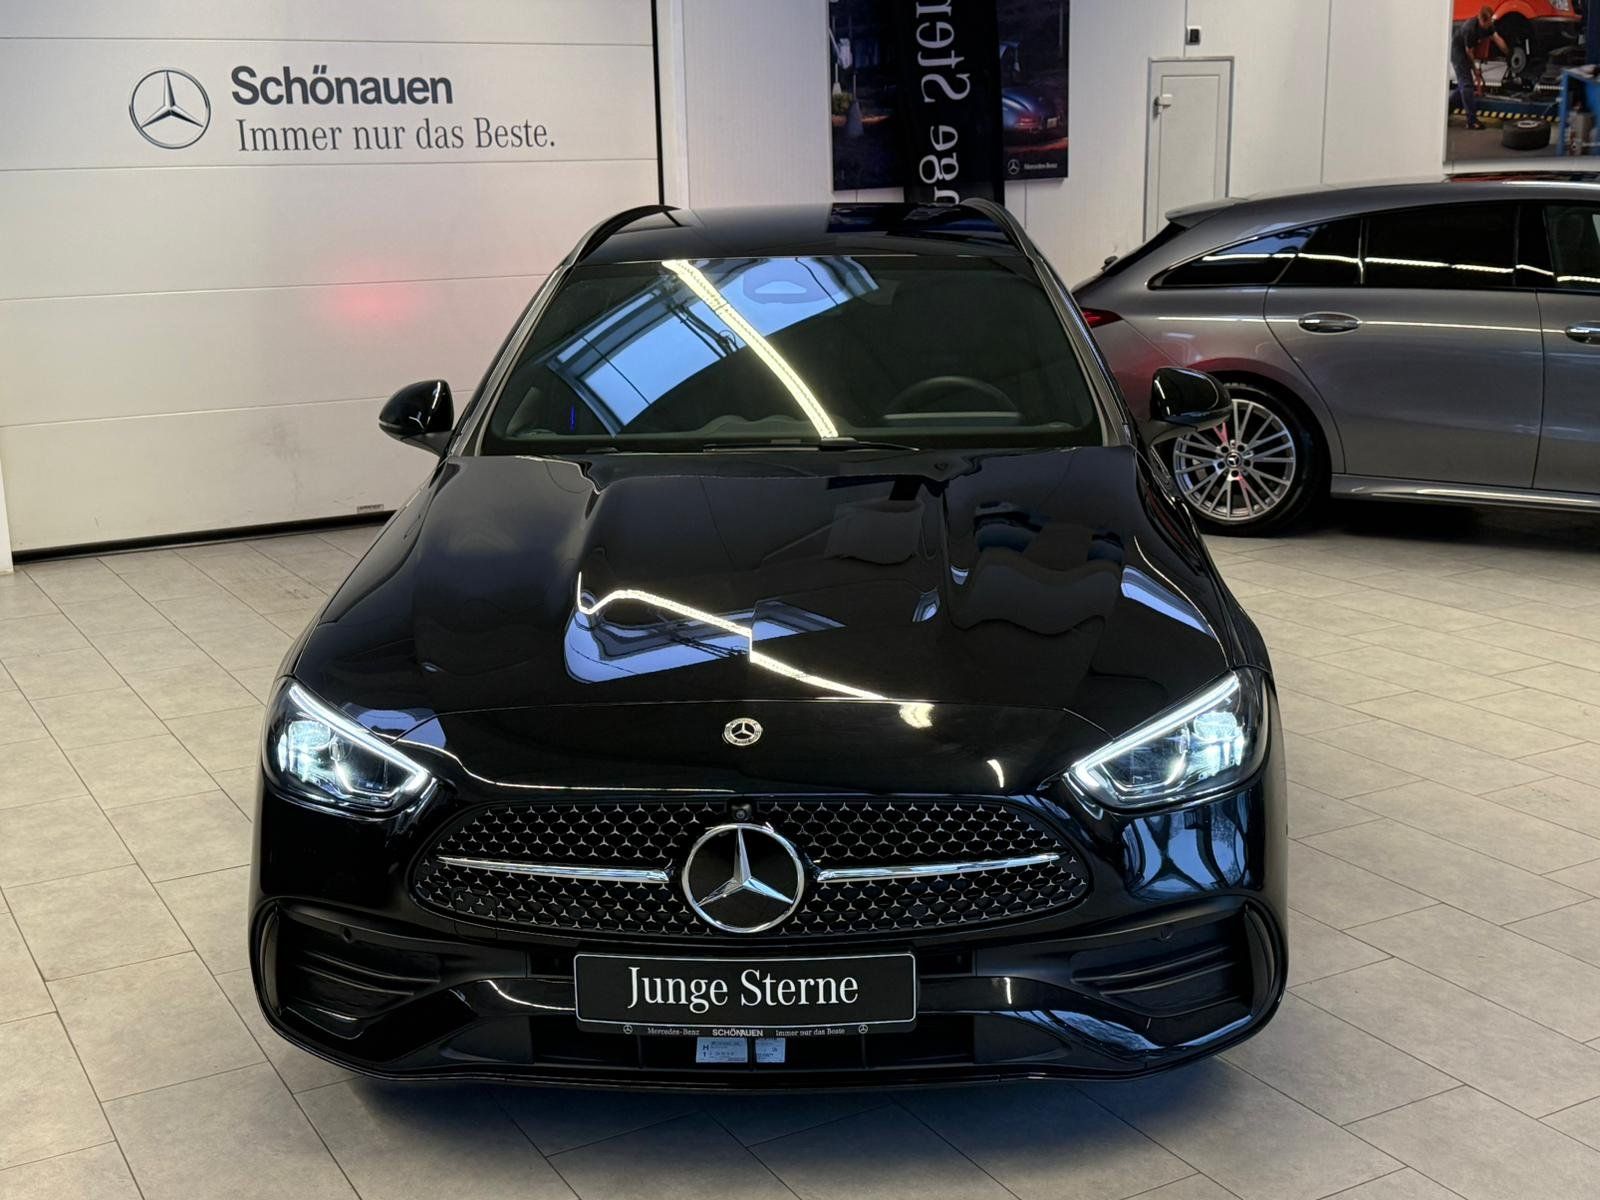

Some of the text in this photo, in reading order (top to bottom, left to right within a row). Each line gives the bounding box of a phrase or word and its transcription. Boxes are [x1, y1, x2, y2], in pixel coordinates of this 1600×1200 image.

[231, 65, 454, 105] Schönauen
[237, 116, 556, 152] Immer nur das Beste.
[627, 966, 859, 1014] Junge Sterne
